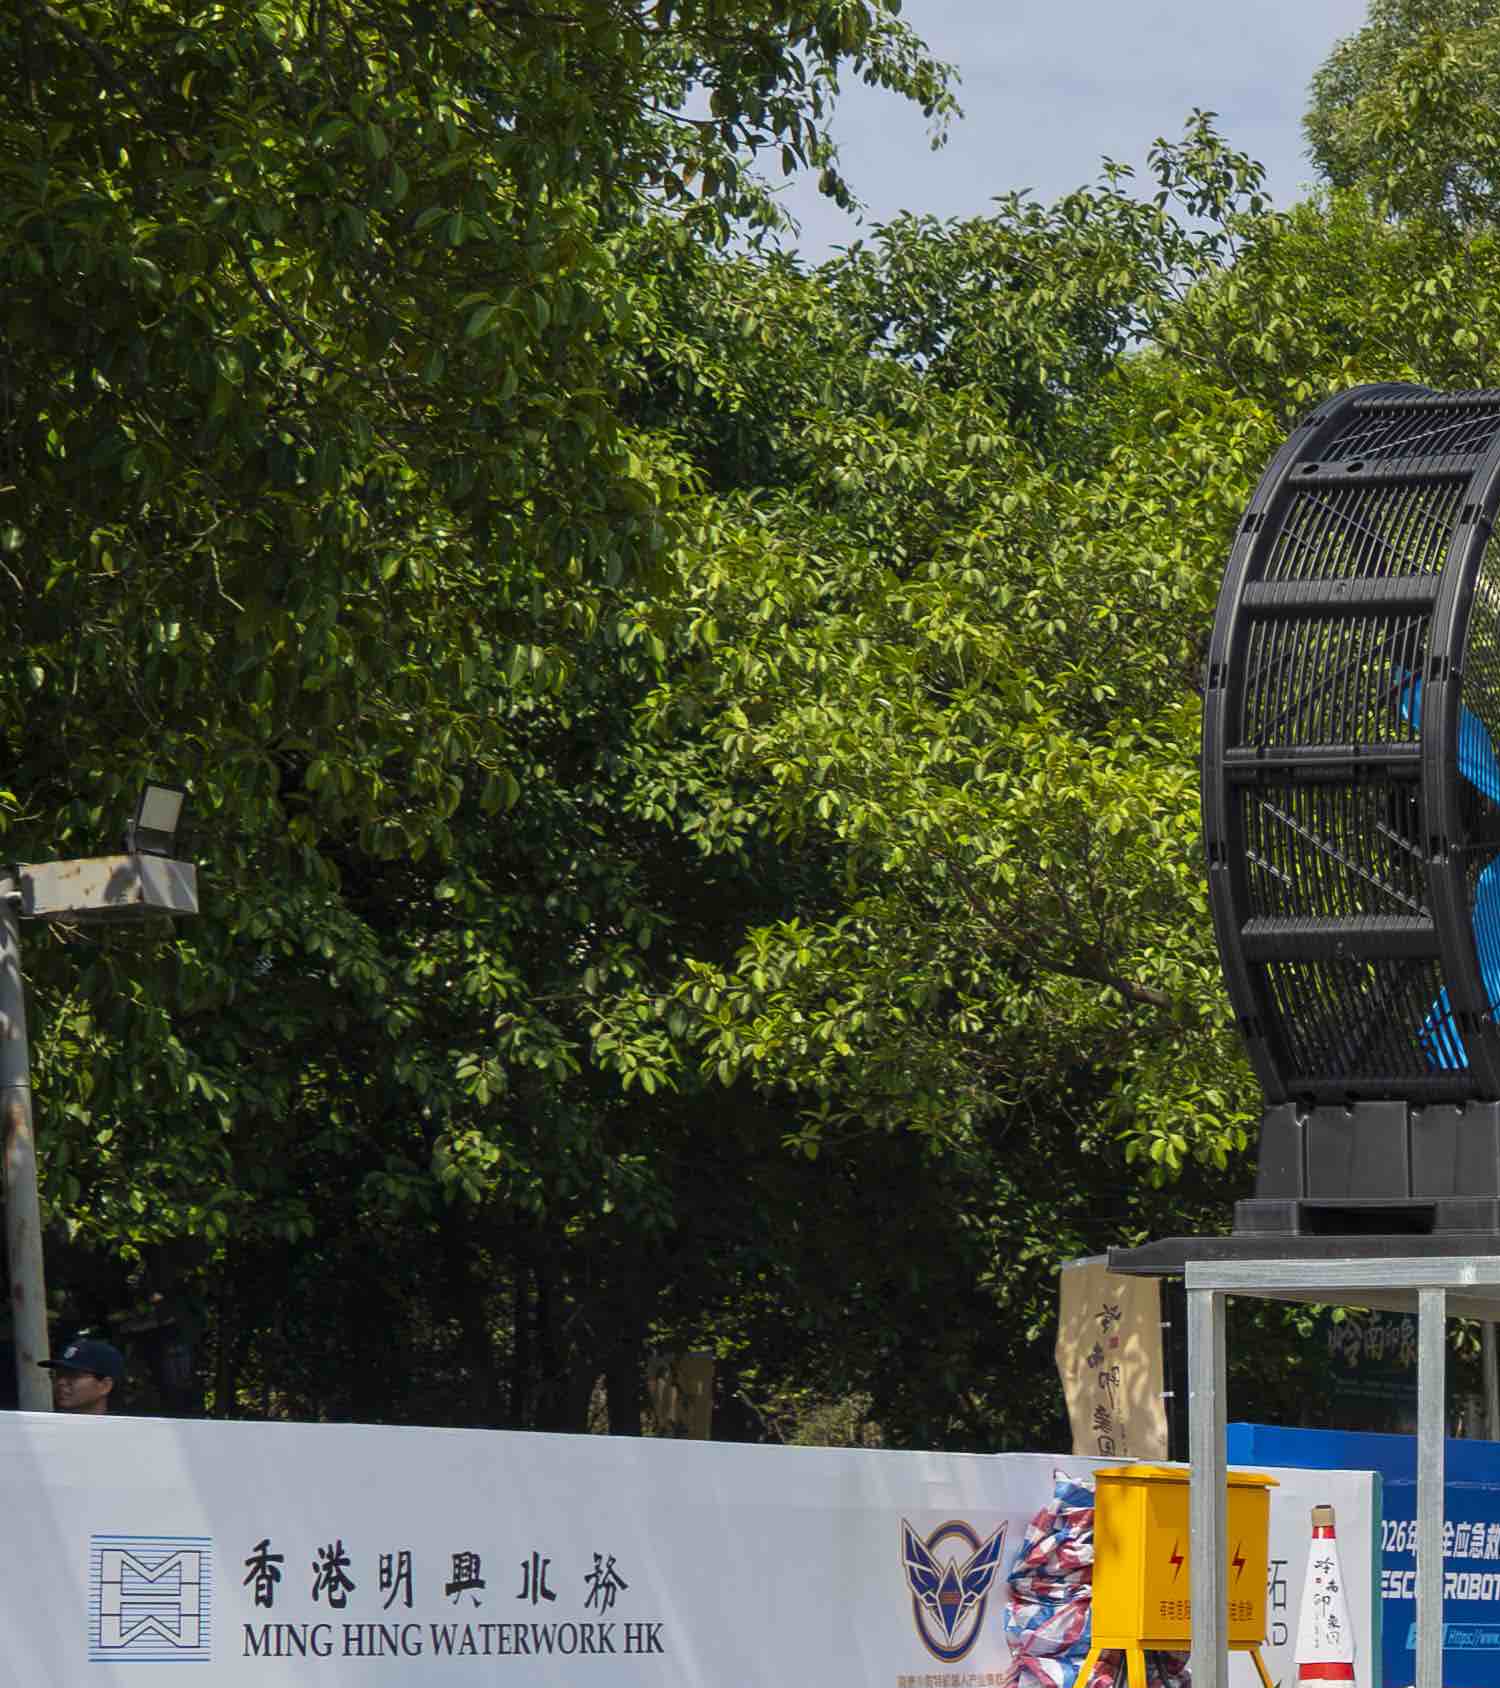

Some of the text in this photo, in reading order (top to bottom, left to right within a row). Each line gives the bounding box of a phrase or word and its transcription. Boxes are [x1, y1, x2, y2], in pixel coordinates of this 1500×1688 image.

[242, 1623, 665, 1657] MING HING WATERWORK HK
